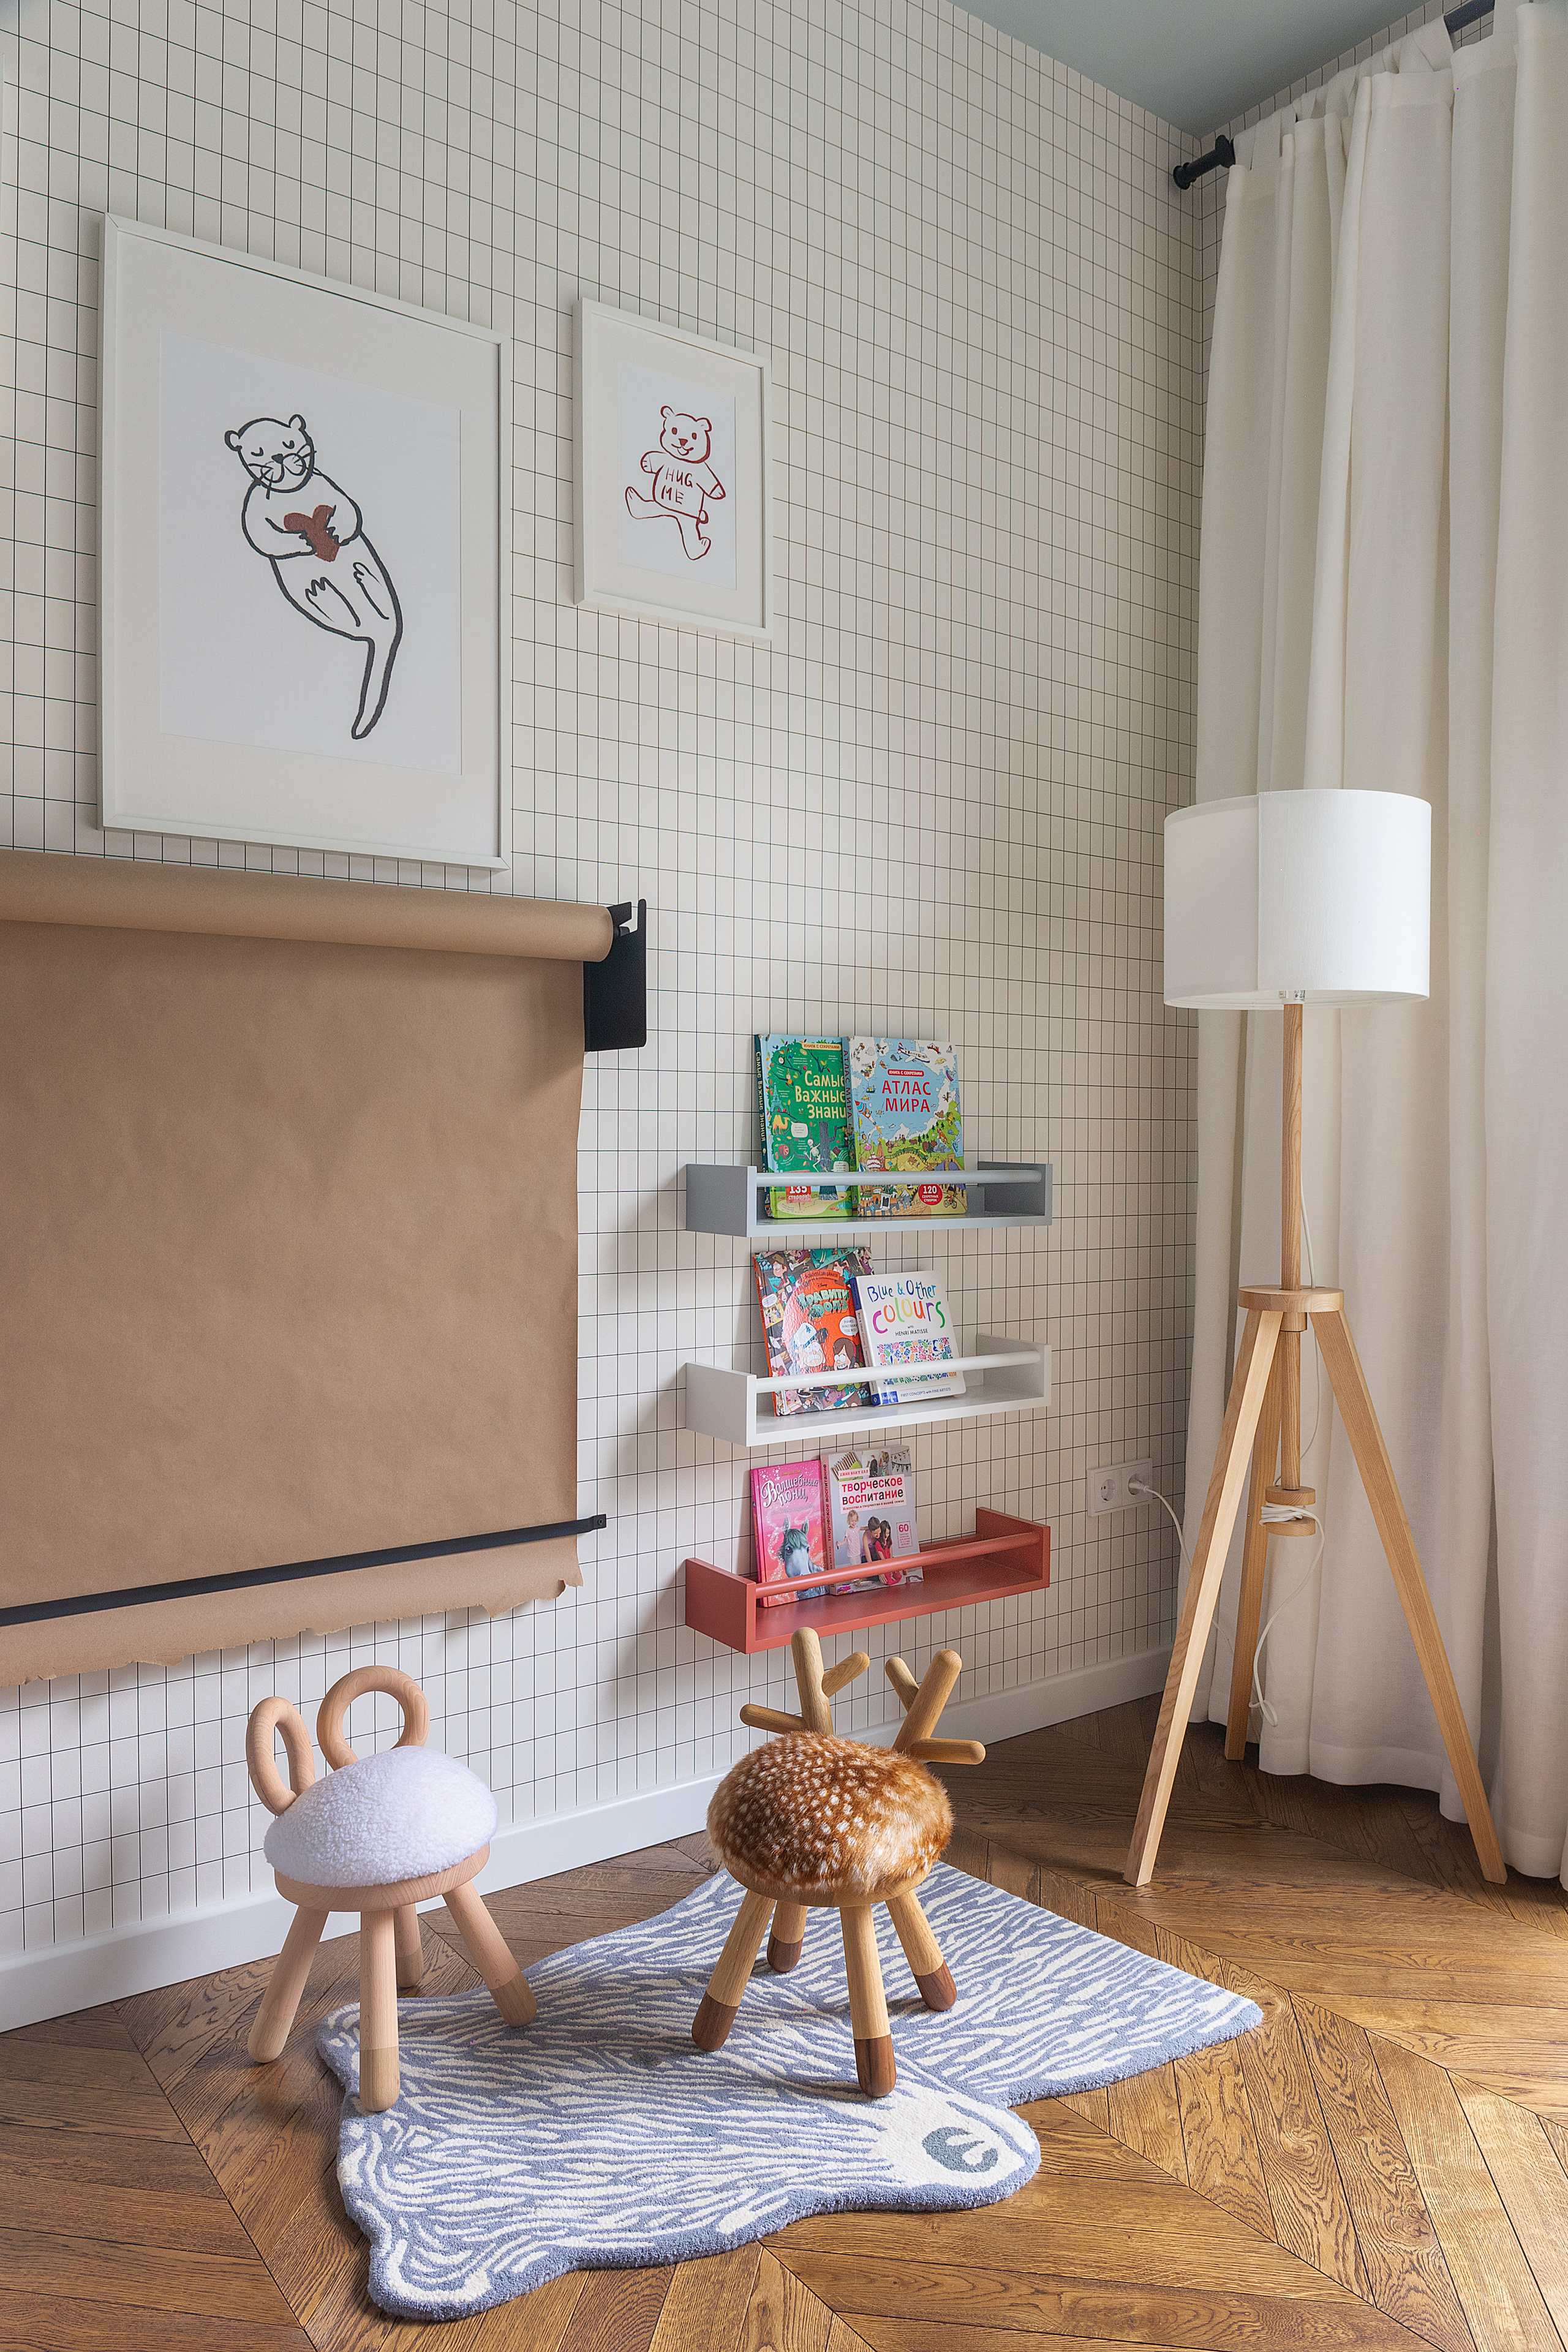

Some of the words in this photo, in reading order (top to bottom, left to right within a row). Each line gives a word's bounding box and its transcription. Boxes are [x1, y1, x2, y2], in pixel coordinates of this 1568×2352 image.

[665, 467, 693, 488] HUG
[661, 485, 684, 505] ME
[805, 1071, 845, 1087] Самые
[795, 1085, 846, 1103] Важные
[881, 1080, 931, 1096] АТЛАС
[807, 1104, 846, 1119] Знани
[885, 1098, 930, 1113] МИРА
[923, 1185, 937, 1194] 120
[867, 1285, 894, 1303] Blue
[897, 1282, 905, 1295] &
[906, 1280, 936, 1300] Other
[761, 1474, 818, 1508] Волшебный
[842, 1477, 903, 1493] творческое
[842, 1488, 903, 1506] воспитание
[899, 1523, 909, 1532] 60
